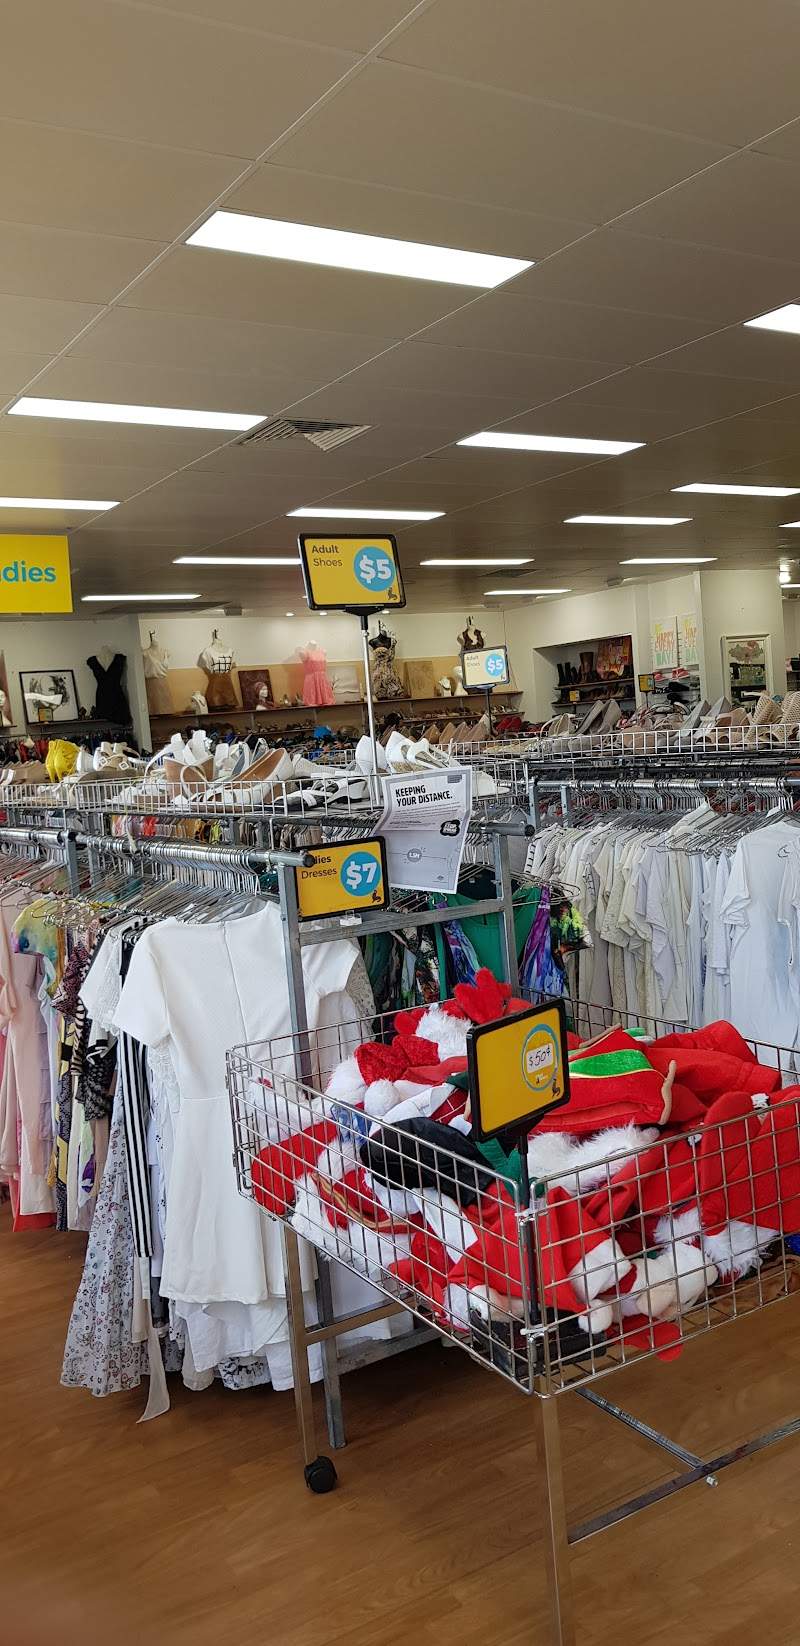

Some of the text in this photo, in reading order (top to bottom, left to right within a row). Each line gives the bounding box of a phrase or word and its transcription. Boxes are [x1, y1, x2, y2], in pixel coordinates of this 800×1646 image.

[311, 544, 340, 554] Adult
[313, 558, 343, 567] Shoes
[359, 554, 392, 584] $5
[0, 560, 57, 582] dies
[487, 658, 504, 673] $5
[395, 784, 426, 798] KEEPING
[396, 796, 417, 807] YOUR
[418, 790, 453, 804] DISTANCE.
[301, 867, 338, 879] Dresses
[346, 860, 377, 889] $7
